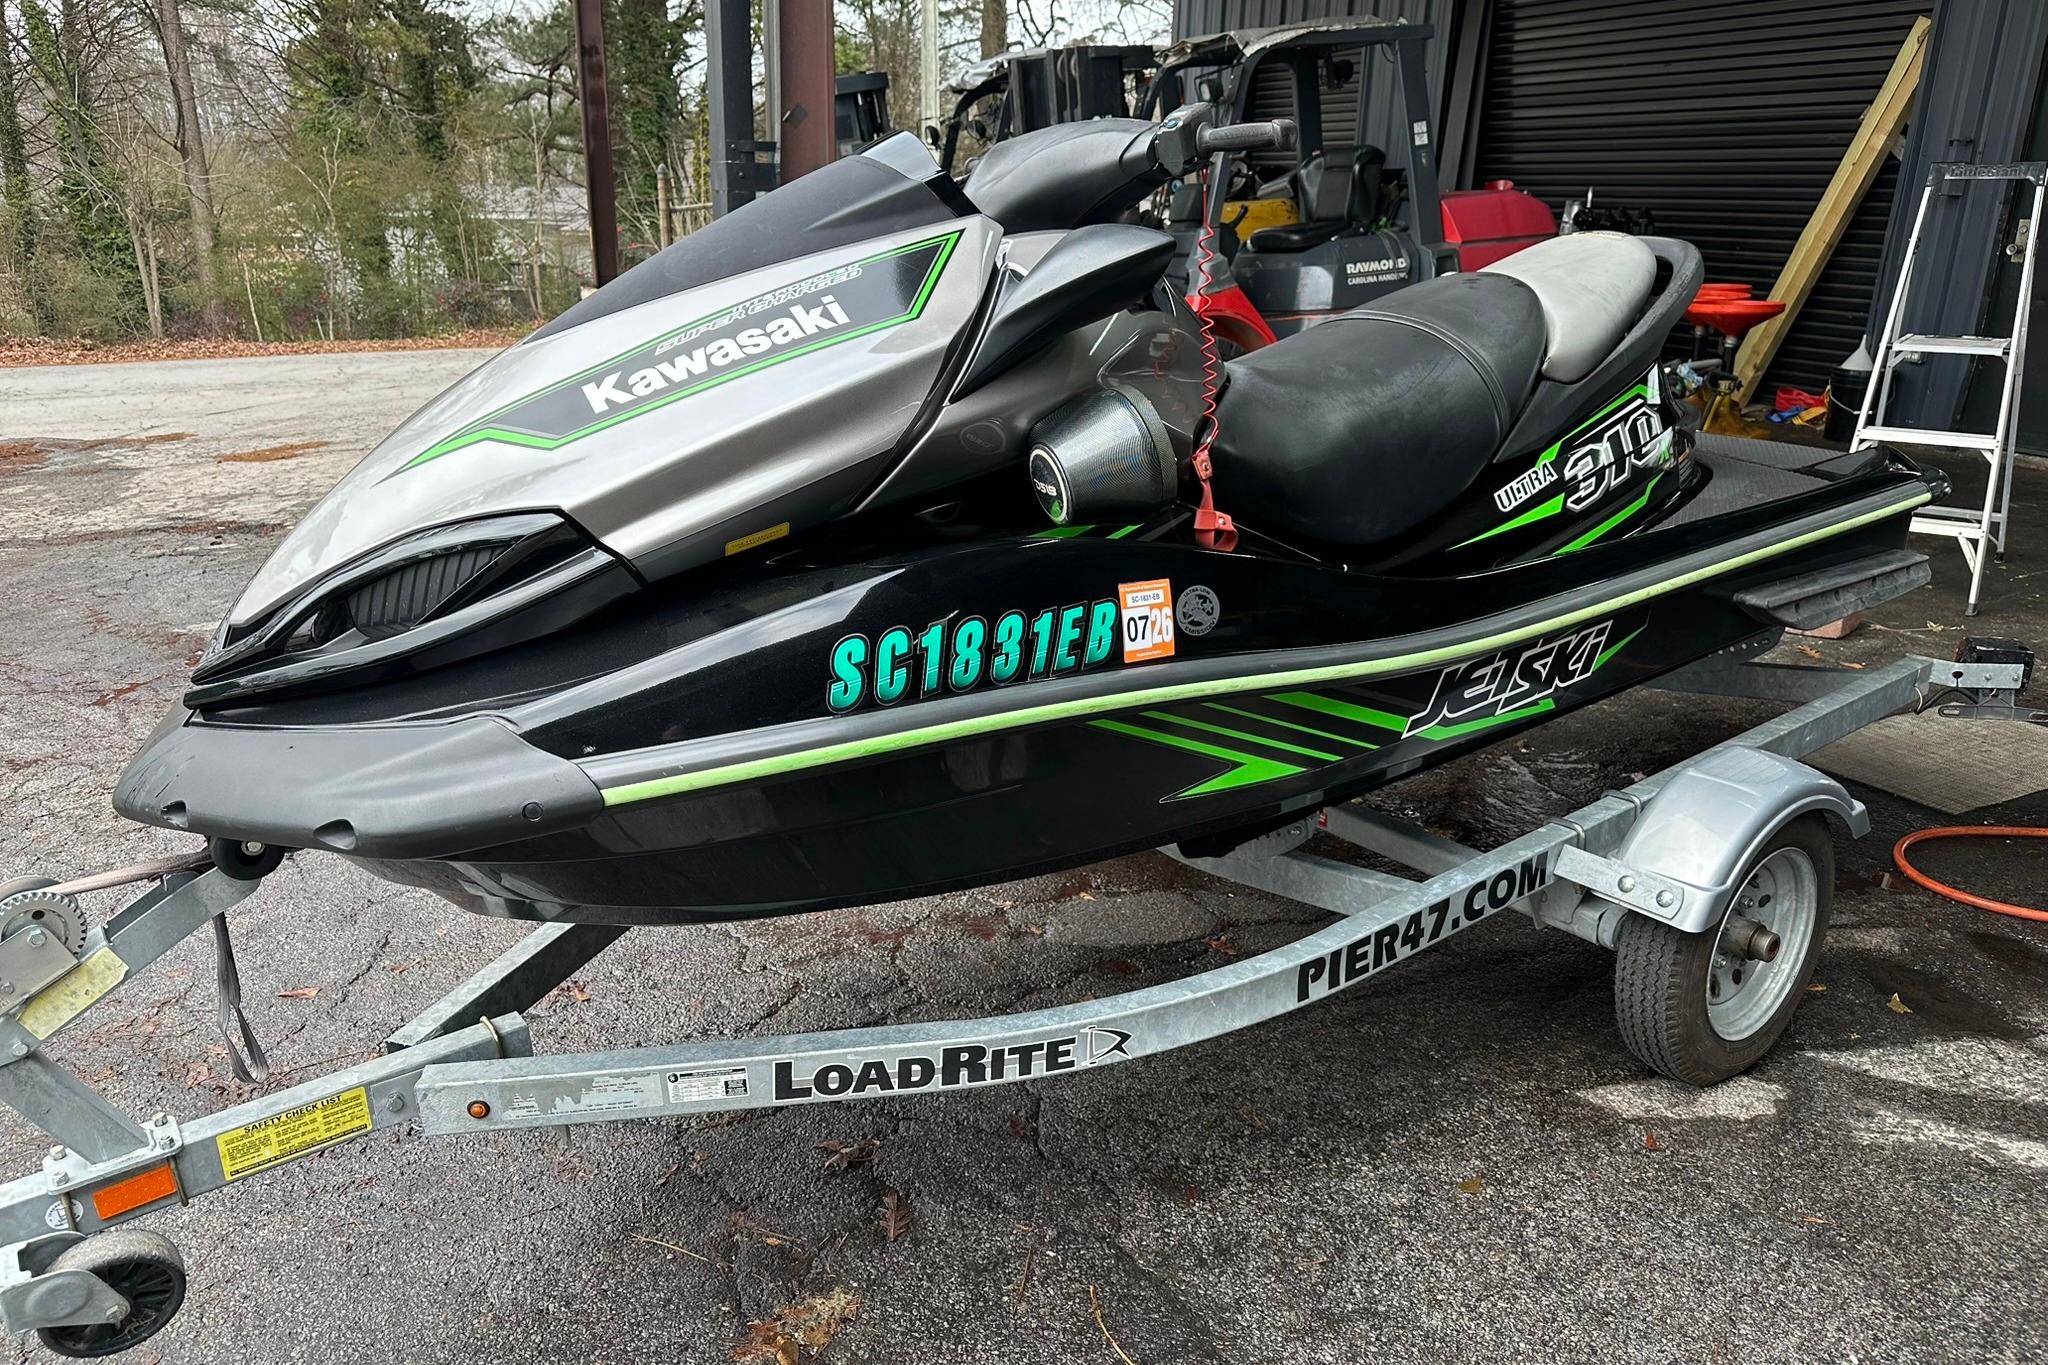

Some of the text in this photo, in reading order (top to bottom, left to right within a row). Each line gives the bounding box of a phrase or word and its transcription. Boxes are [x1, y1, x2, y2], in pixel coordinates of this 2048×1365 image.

[1346, 257, 1407, 274] RAYMOND
[1347, 275, 1378, 286] CAROLINA
[655, 268, 863, 356] SUPER CHARGED
[581, 294, 851, 415] Kawasaki
[1494, 459, 1558, 512] ULTRA
[1563, 406, 1664, 512] 310
[1131, 592, 1161, 604] SC-1831-EB
[1127, 606, 1173, 644] 07 26
[1298, 851, 1549, 1003] PIER47.COM
[244, 1094, 343, 1134] SAFETY CHECK LIST
